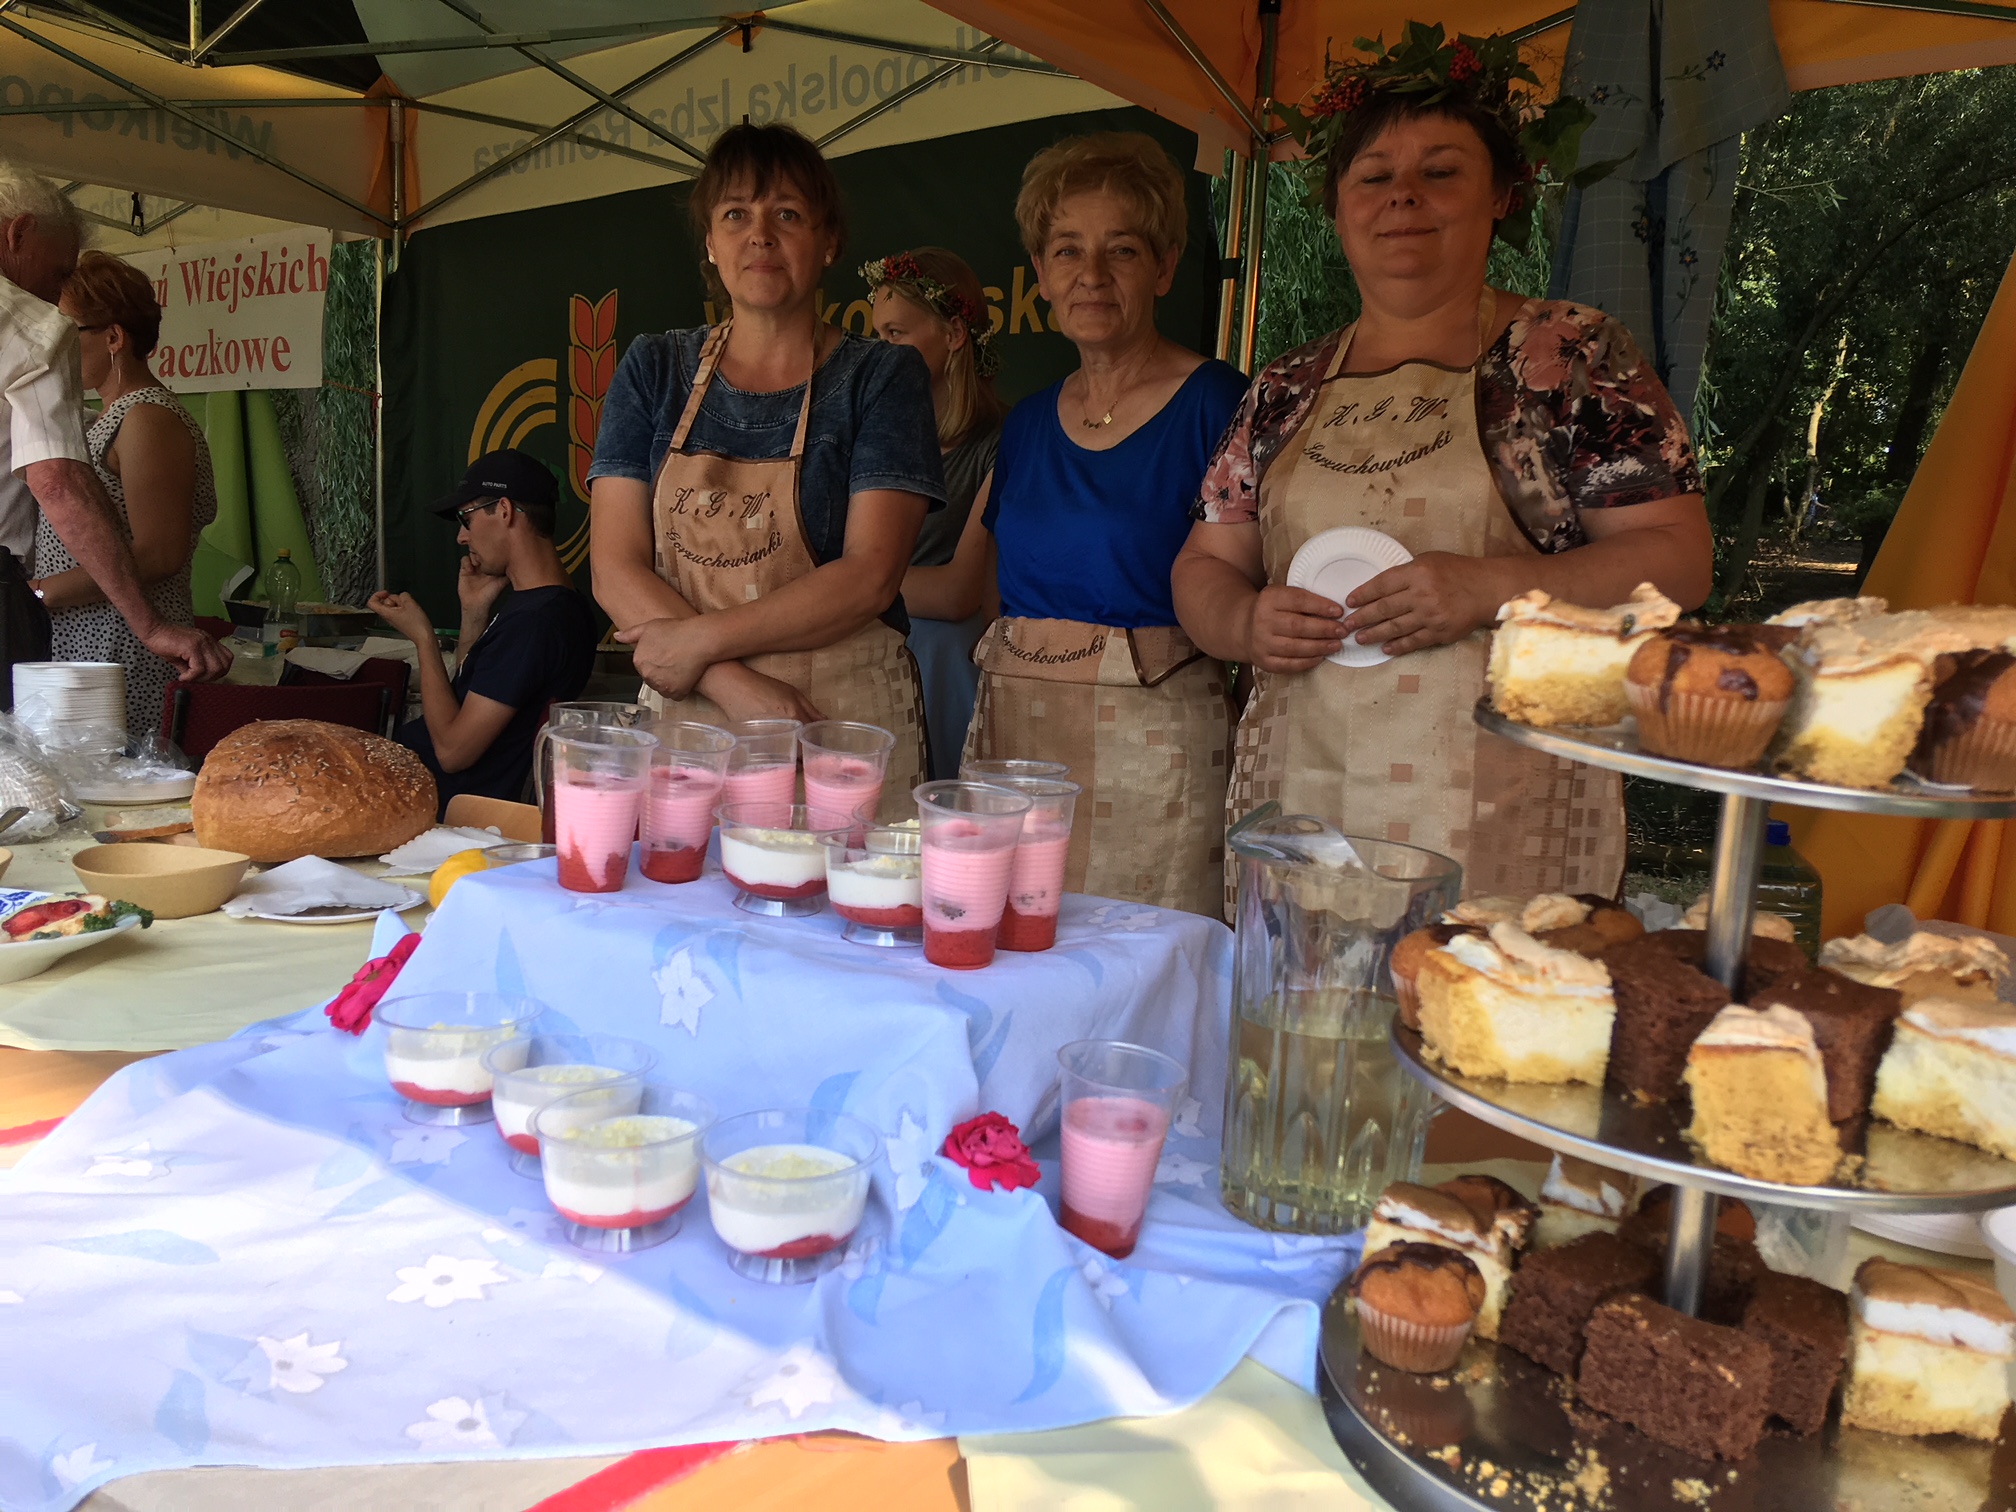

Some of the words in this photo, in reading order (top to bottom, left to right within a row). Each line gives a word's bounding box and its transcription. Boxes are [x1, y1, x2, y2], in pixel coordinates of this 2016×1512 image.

[178, 243, 328, 313] Wiejskich
[147, 328, 292, 378] aczkowe
[1302, 430, 1454, 475] Gorzuchowianki
[665, 527, 784, 568] Gorzuchowianki
